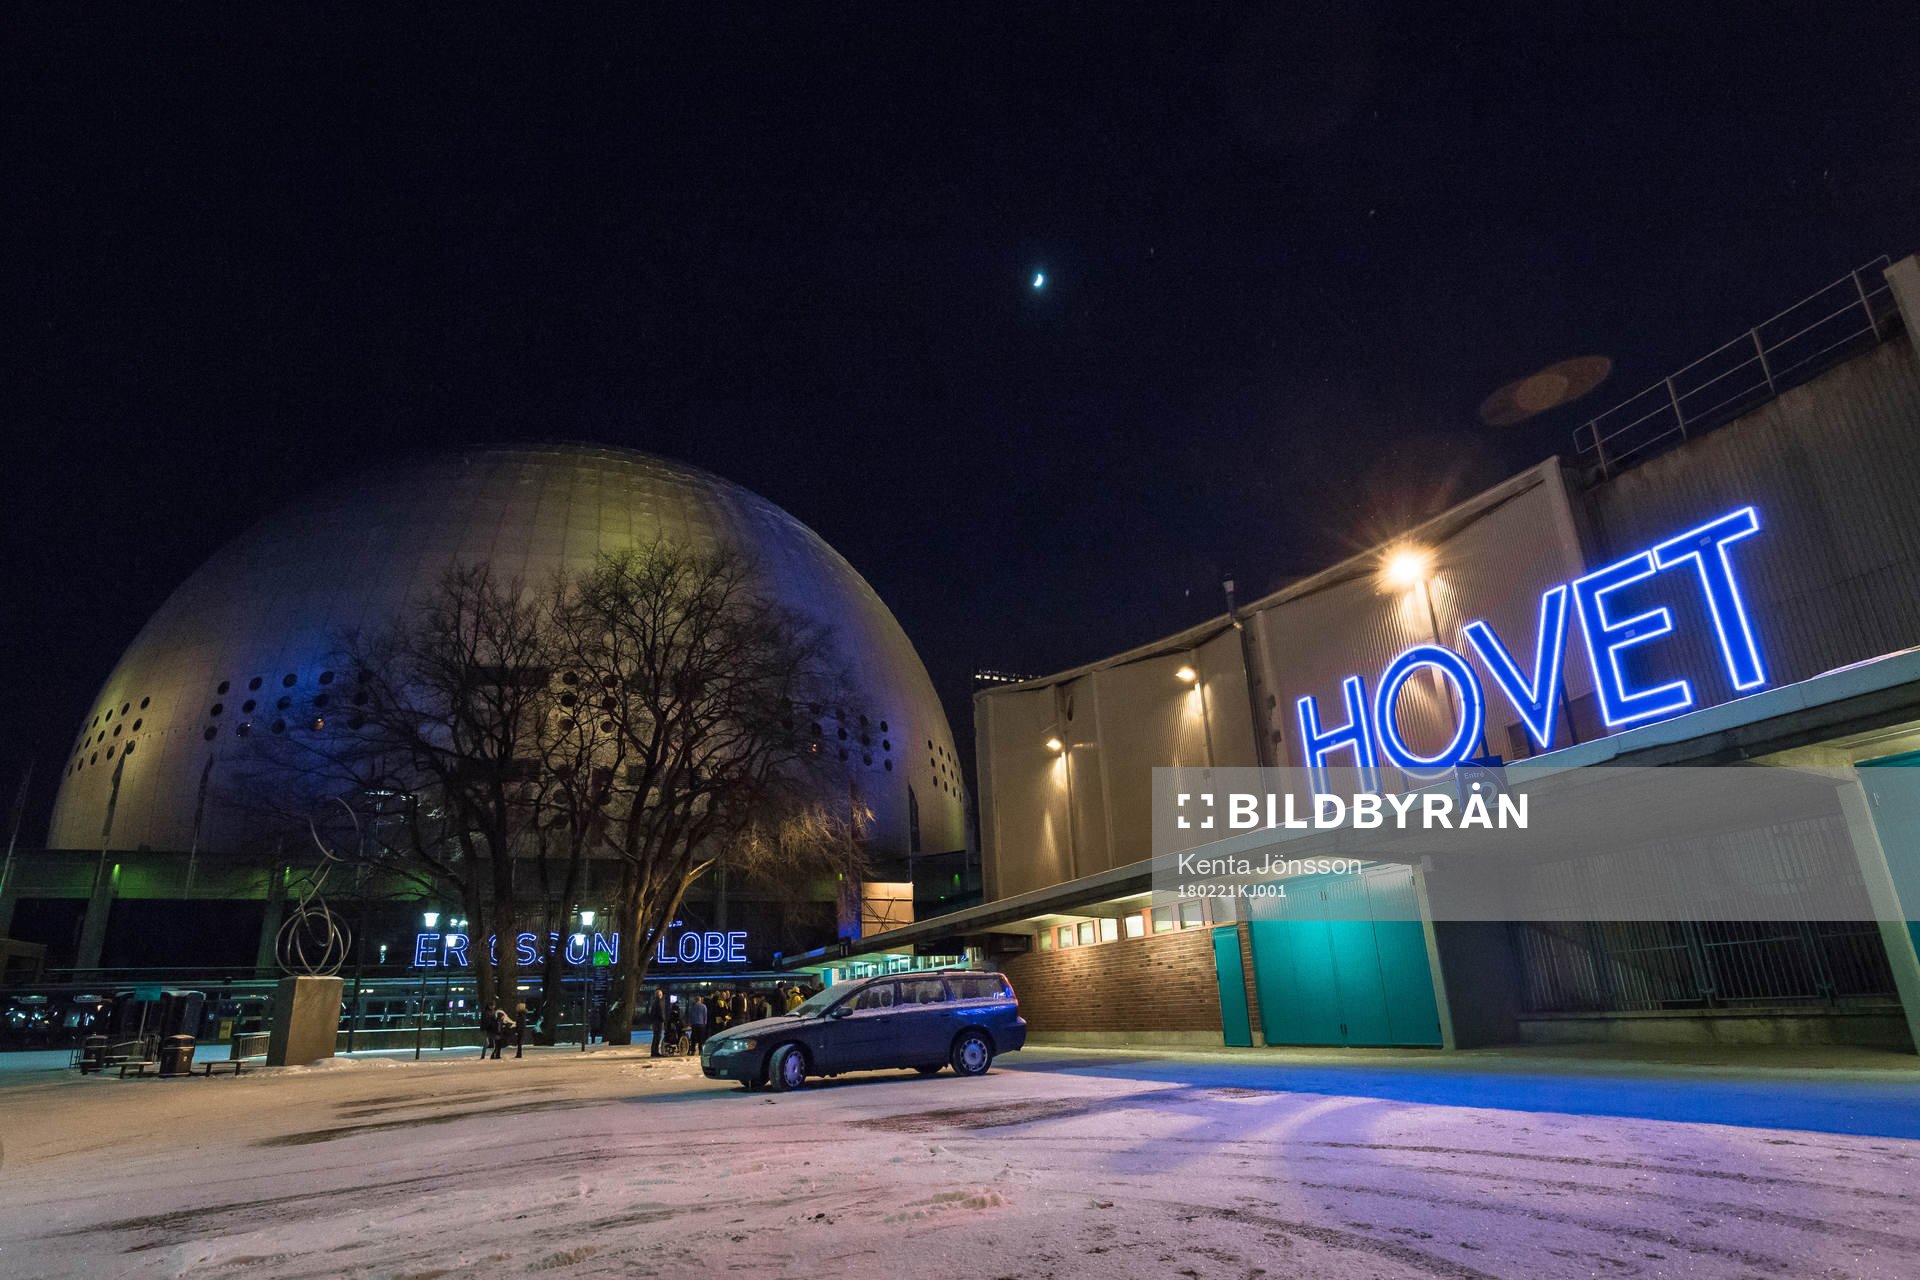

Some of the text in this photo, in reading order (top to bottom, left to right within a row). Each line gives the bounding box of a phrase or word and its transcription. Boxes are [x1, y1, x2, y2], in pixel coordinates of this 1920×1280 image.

[1296, 505, 1766, 810] HOVET
[414, 930, 748, 967] ERSON LOBE
